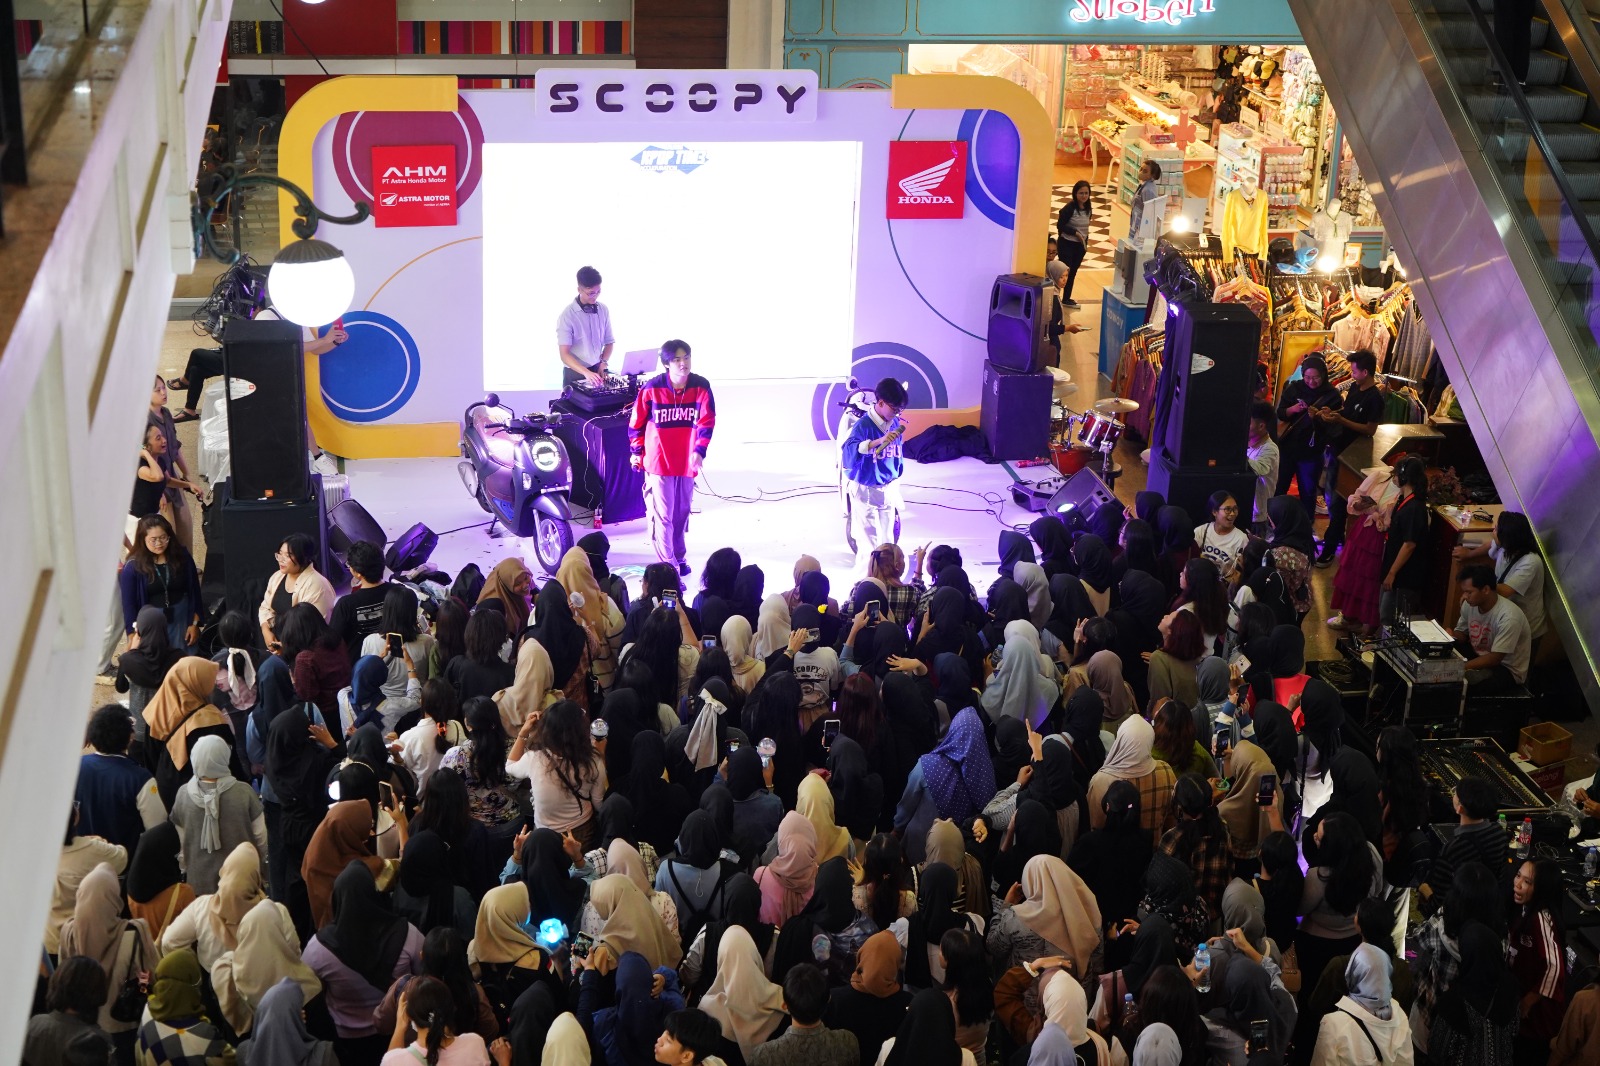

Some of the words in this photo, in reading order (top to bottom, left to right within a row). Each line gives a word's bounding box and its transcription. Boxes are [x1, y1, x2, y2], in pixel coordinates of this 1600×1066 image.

[549, 83, 807, 114] SCOOPY
[382, 166, 447, 177] AHM
[898, 196, 954, 204] HONDA
